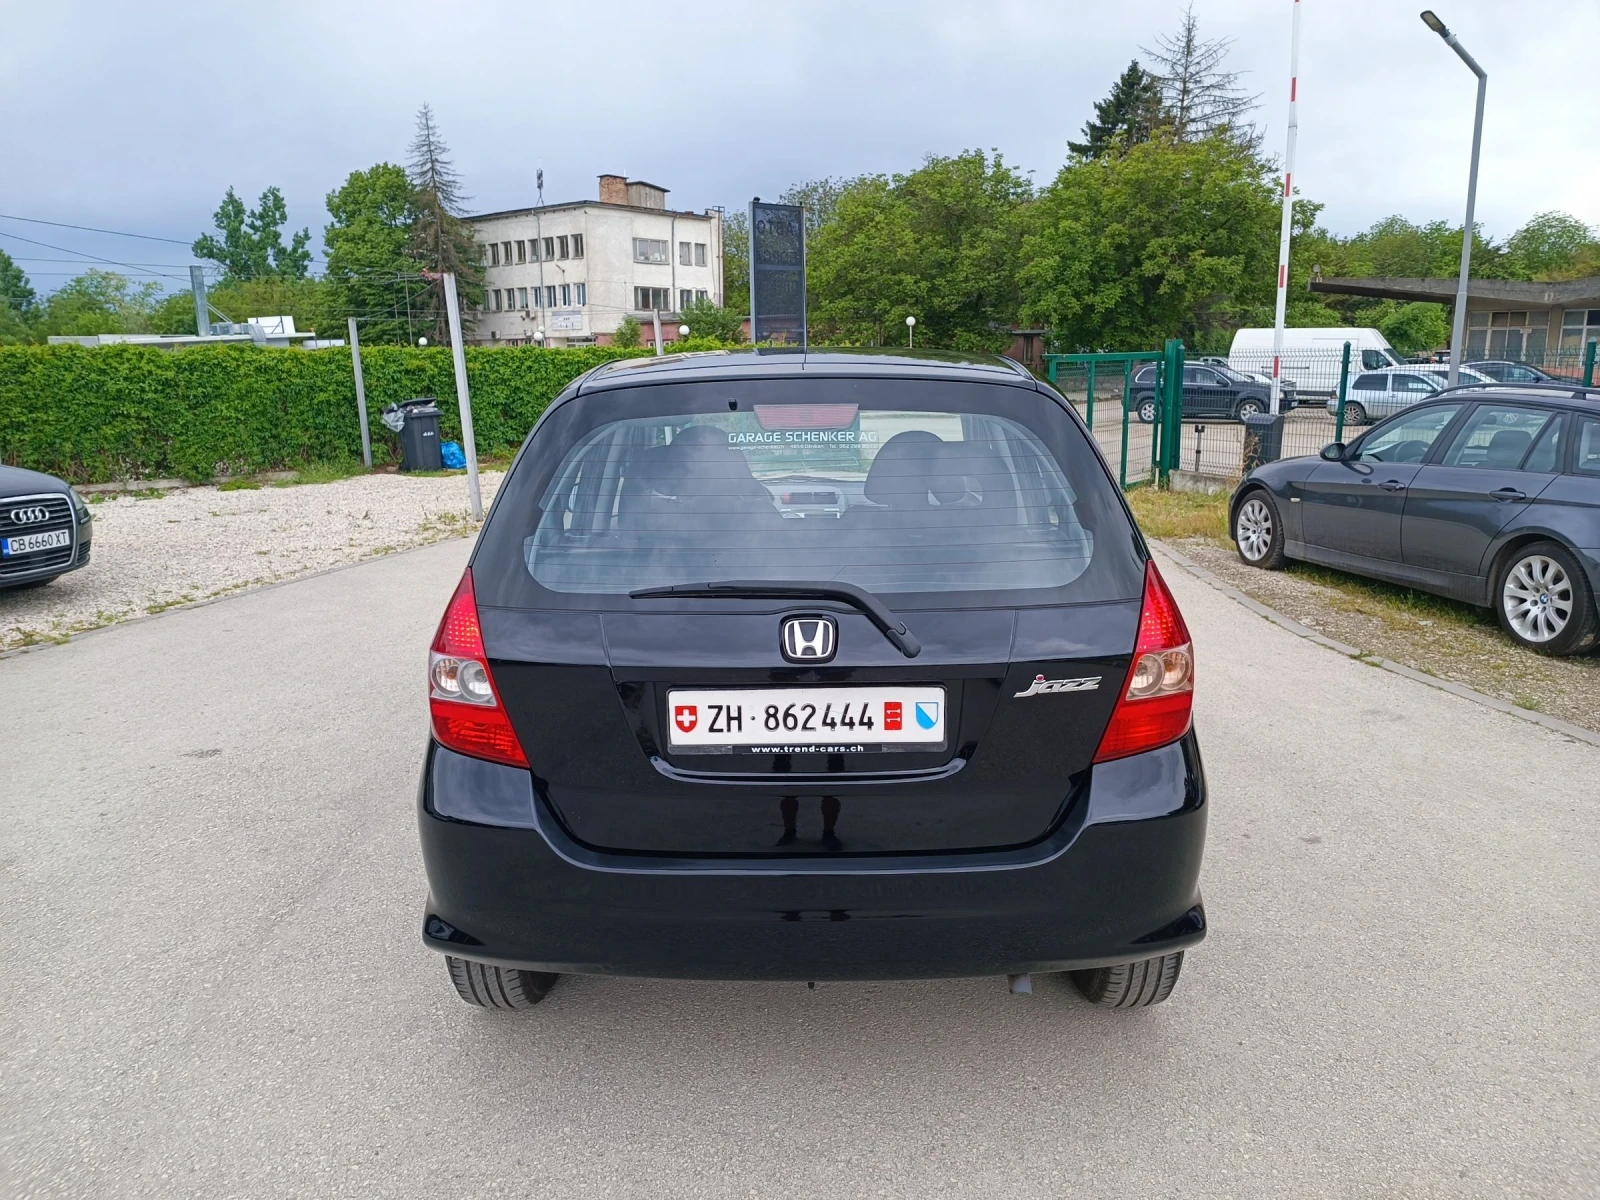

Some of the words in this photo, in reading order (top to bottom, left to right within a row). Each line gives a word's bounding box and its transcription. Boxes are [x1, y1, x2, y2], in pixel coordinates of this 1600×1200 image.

[728, 432, 781, 443] GARAGE
[785, 431, 855, 442] SCHENKER
[859, 431, 877, 442] AG
[11, 538, 26, 552] CB
[28, 534, 53, 549] 6660
[55, 531, 66, 545] XT
[707, 705, 742, 733] ZH
[764, 702, 874, 731] 862444
[751, 744, 864, 754] www.trend-cars.ch
